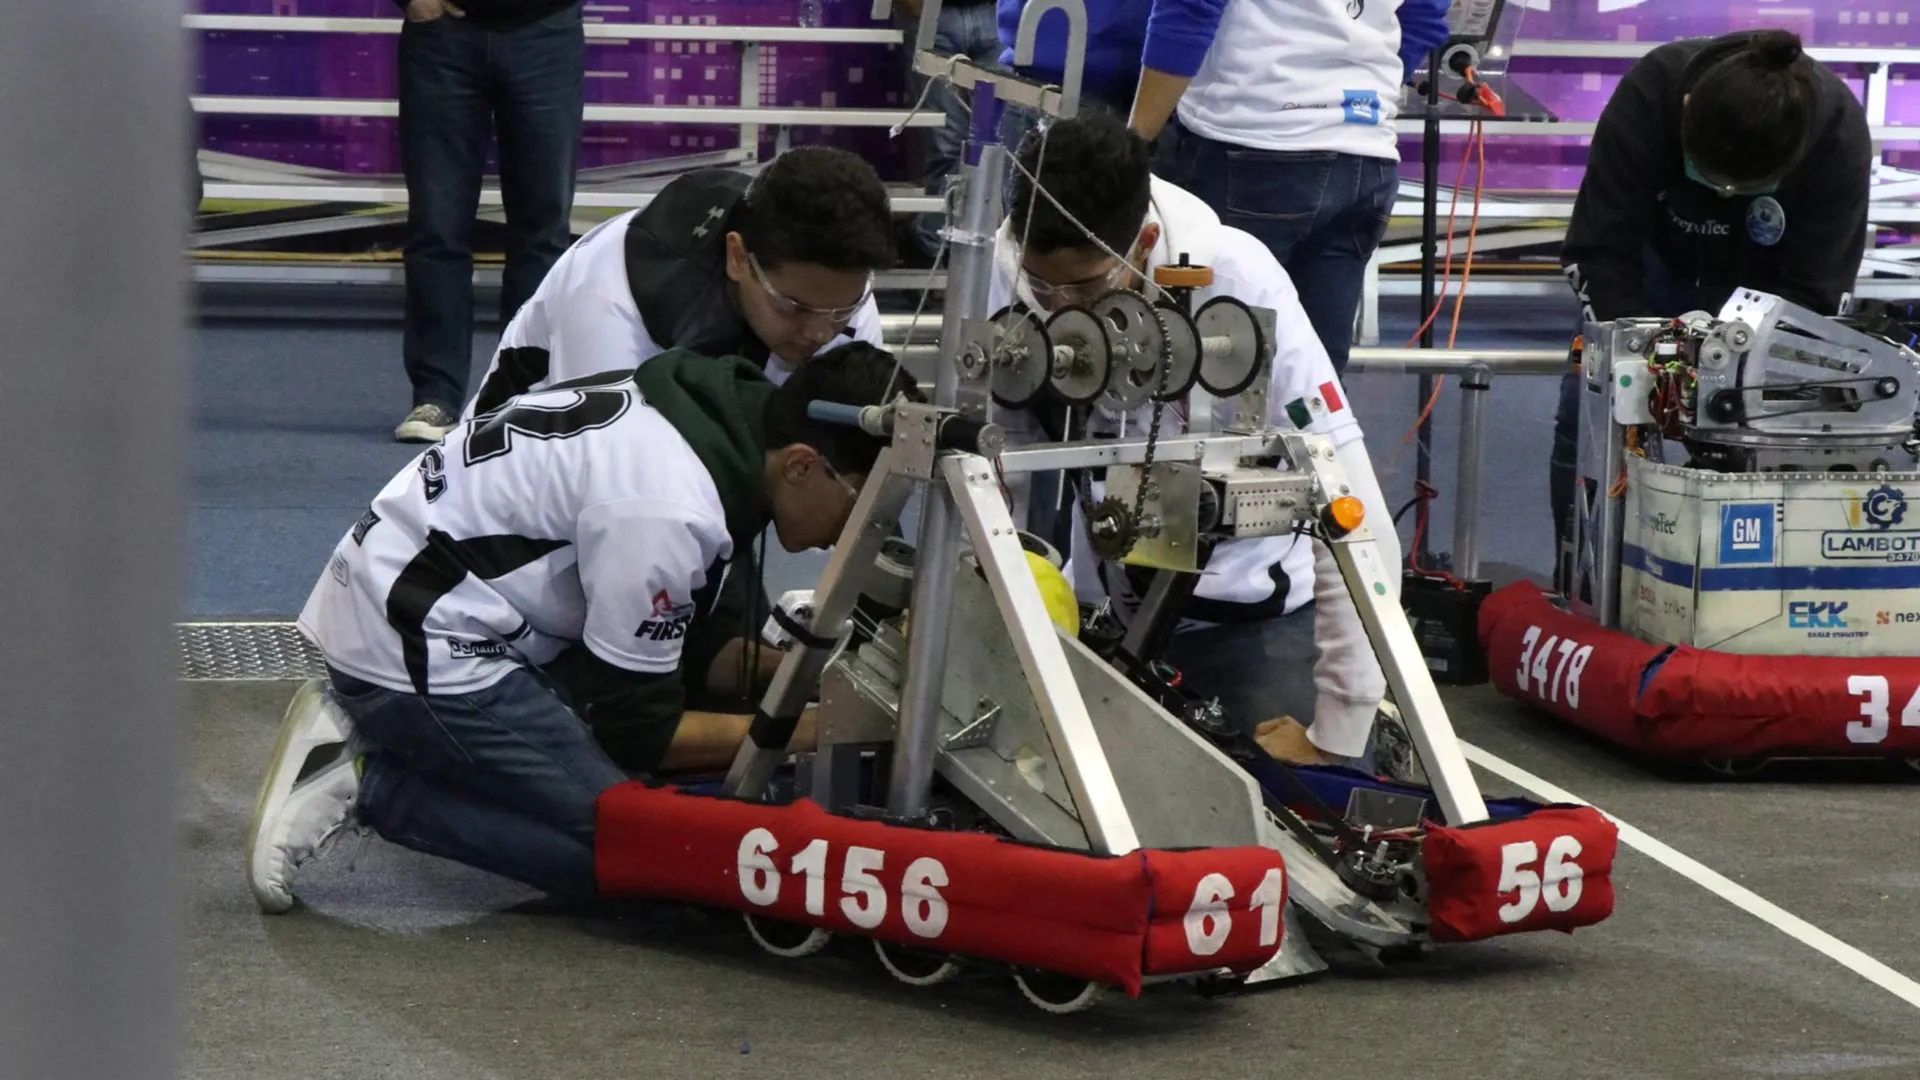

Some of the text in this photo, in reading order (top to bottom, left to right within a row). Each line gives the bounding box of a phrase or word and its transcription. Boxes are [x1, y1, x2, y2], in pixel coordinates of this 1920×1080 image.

[1732, 518, 1761, 542] GM
[1828, 536, 1920, 552] LAMBOT
[1888, 553, 1920, 562] 3478
[1789, 601, 1848, 628] EKK
[1516, 625, 1594, 710] 3478
[737, 827, 949, 938] 6156
[1497, 834, 1584, 923] 56
[1183, 867, 1282, 956] 61
